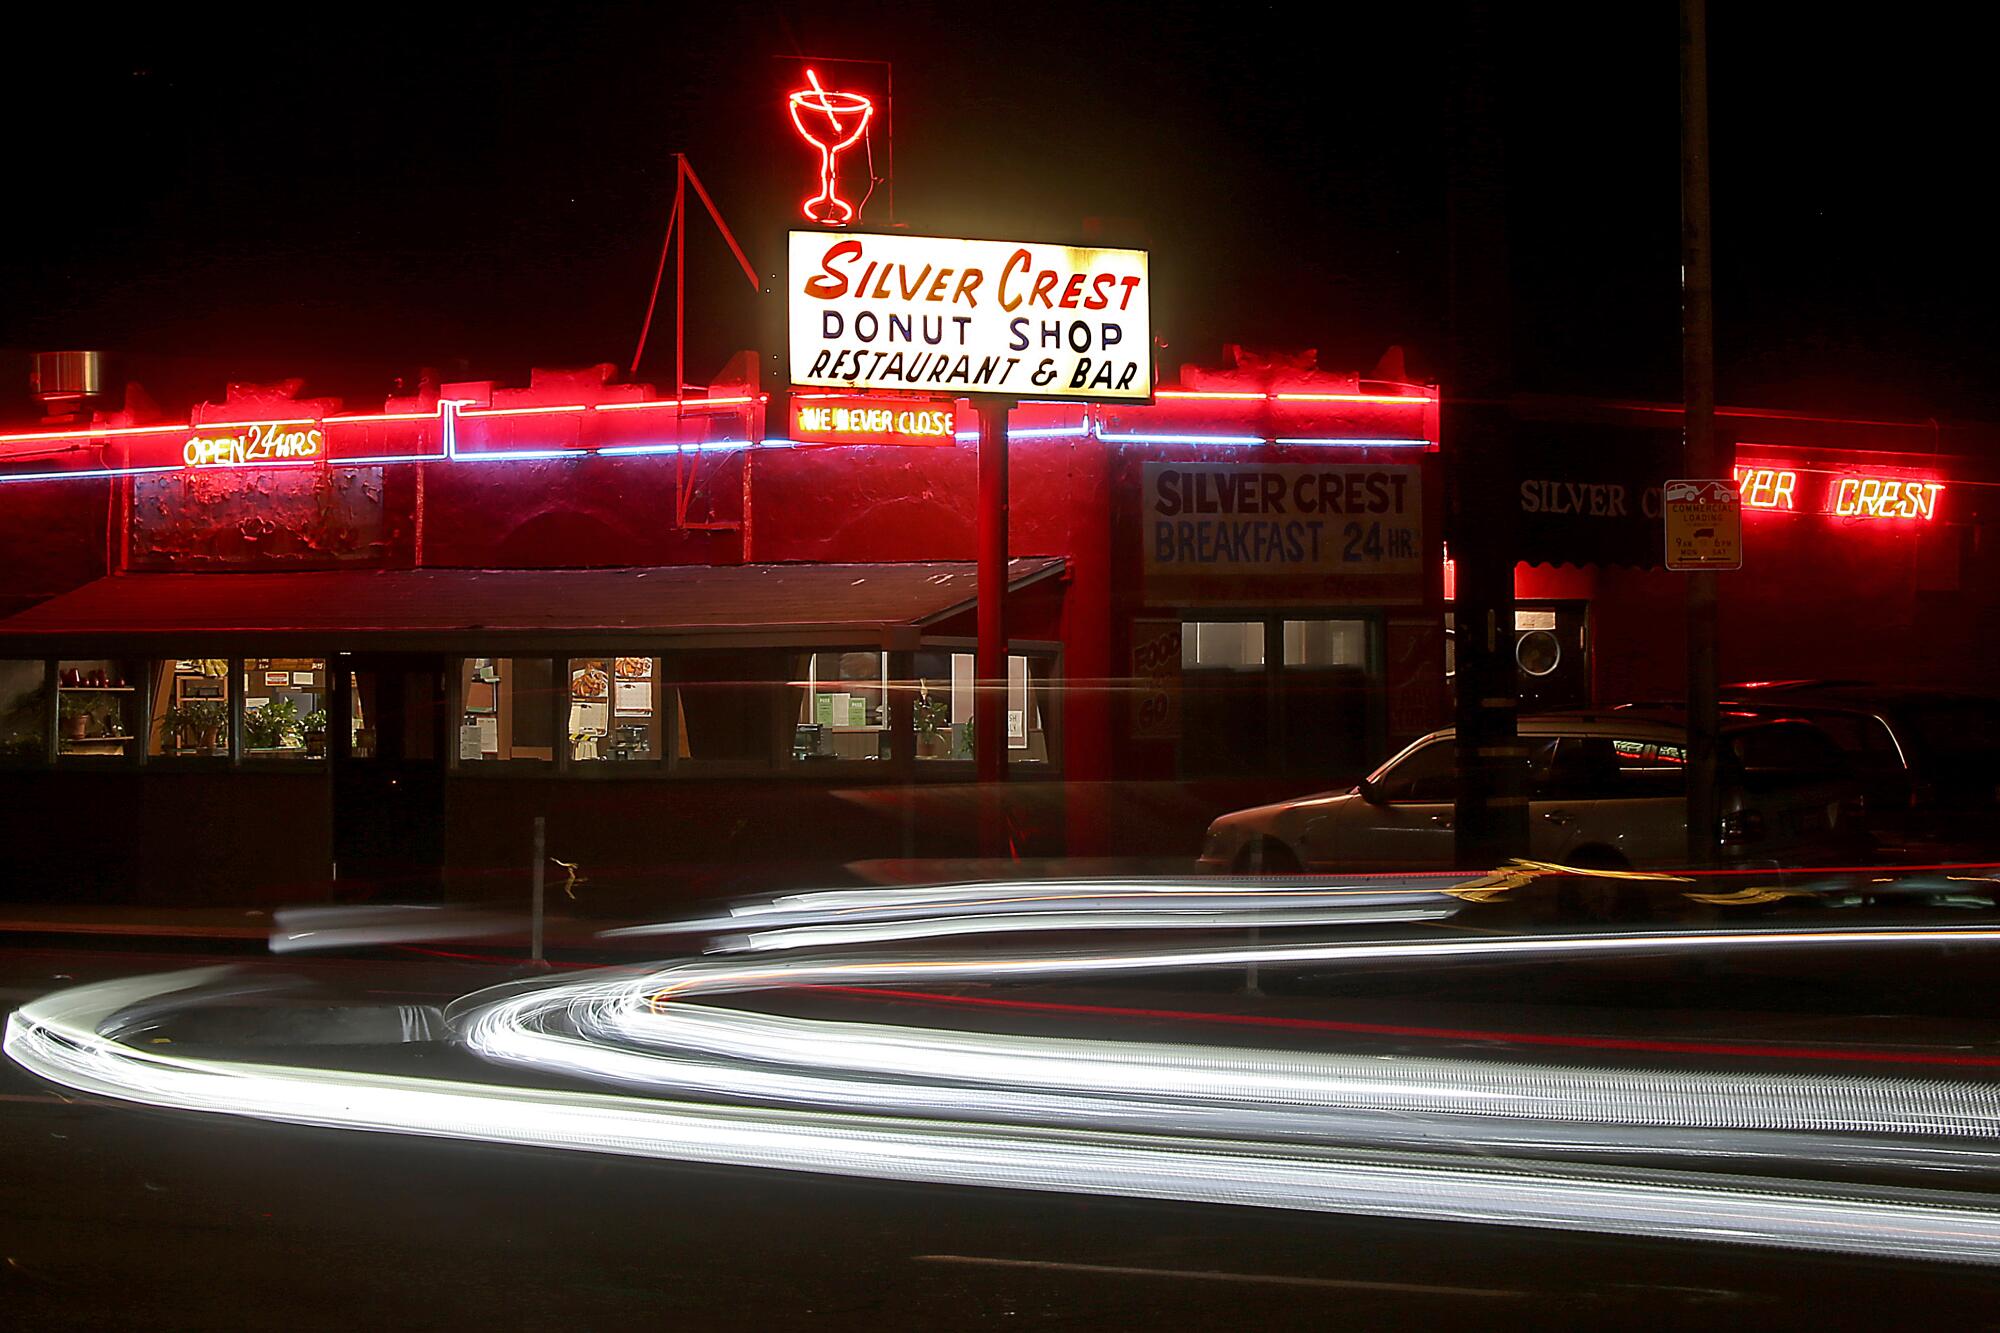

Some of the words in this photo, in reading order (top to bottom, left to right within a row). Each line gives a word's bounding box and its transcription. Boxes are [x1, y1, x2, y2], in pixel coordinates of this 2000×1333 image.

[804, 240, 984, 309] SILVER
[997, 248, 1141, 312] CREST
[823, 310, 972, 345] DONUT
[1009, 317, 1123, 354] SHOP
[807, 349, 1020, 386] RESTAURANT
[1031, 358, 1058, 386] &
[1069, 357, 1138, 391] BAR
[898, 411, 955, 436] CLOSE
[183, 435, 246, 465] OPEN
[1154, 470, 1287, 517] SILVER
[1293, 472, 1408, 515] CREST
[1521, 479, 1628, 517] SILVER
[1672, 504, 1734, 513] COMMERCIAL
[1836, 479, 1946, 521] CREST
[1683, 513, 1723, 522] LOADING
[1155, 521, 1324, 562] BREAKFAST
[1343, 521, 1385, 562] 24
